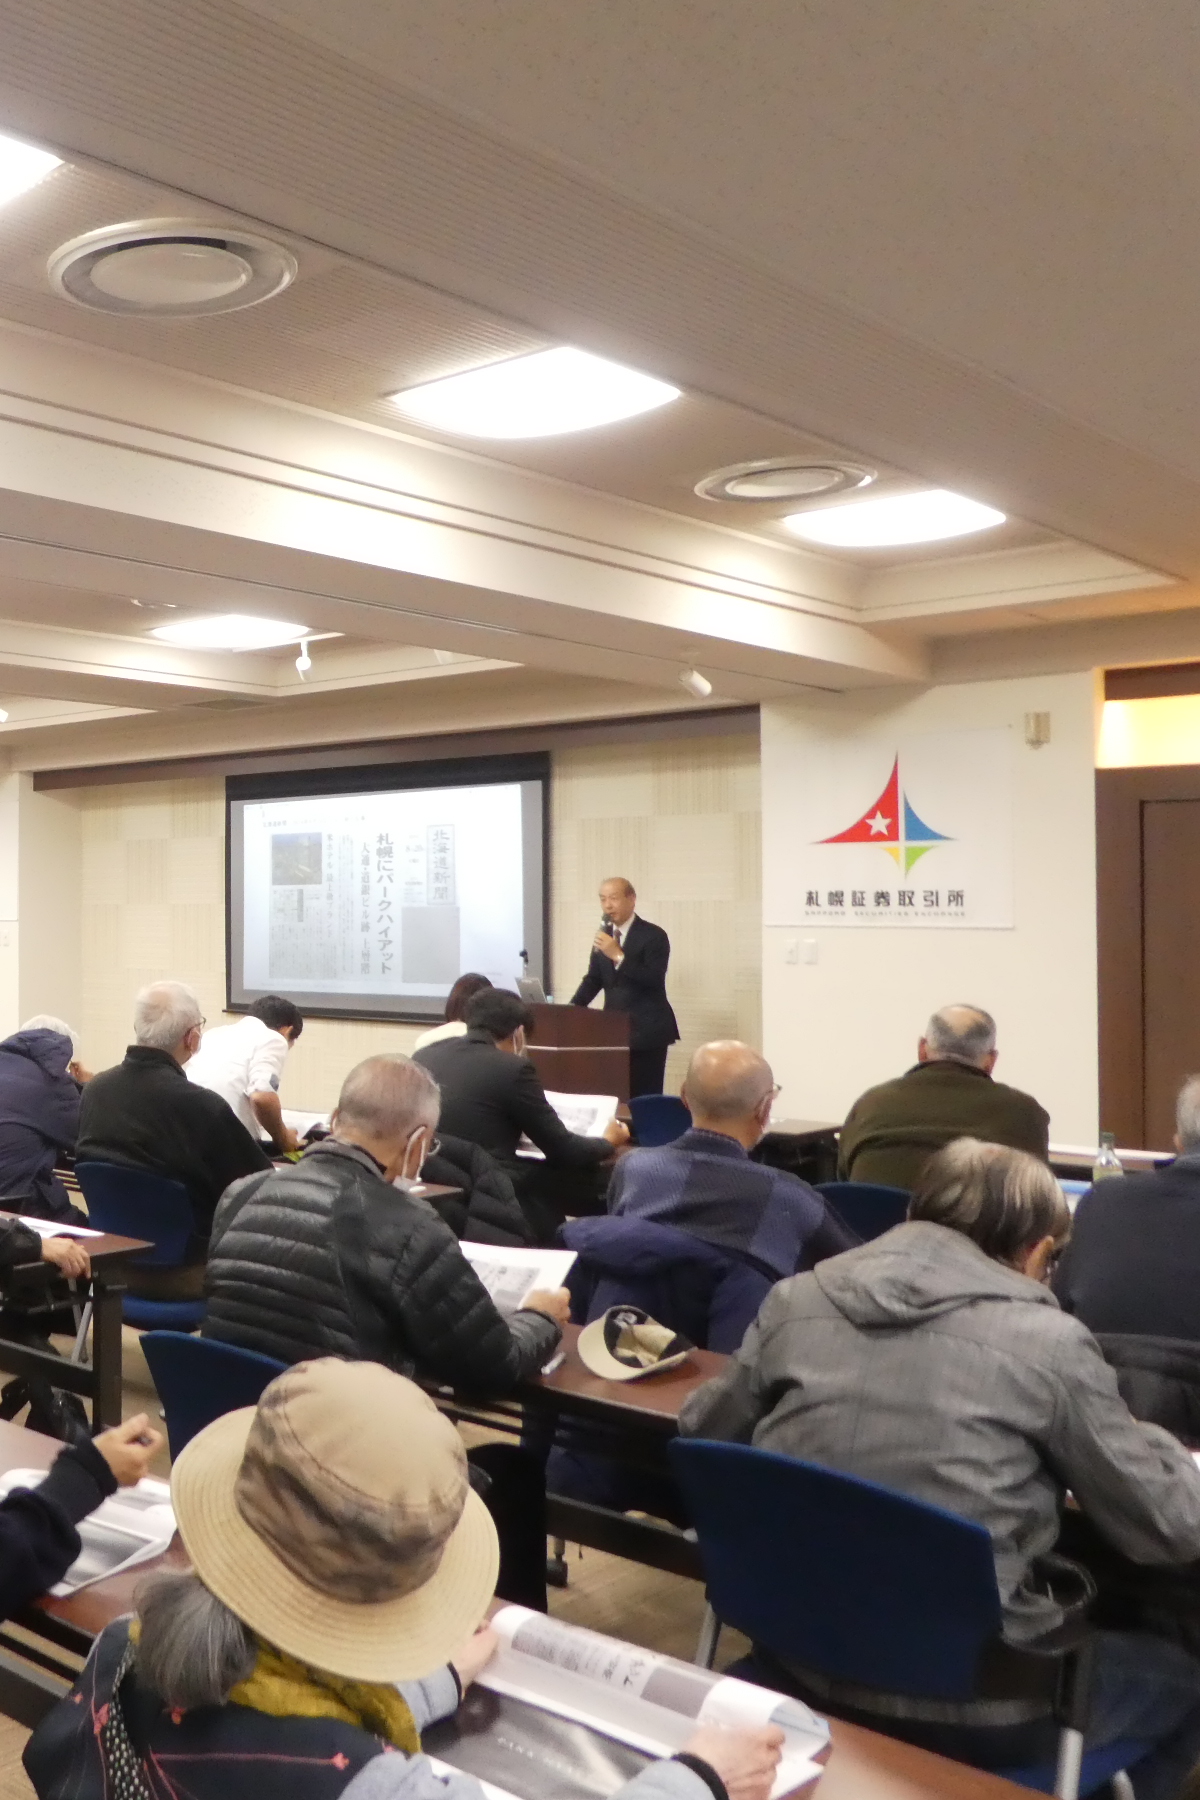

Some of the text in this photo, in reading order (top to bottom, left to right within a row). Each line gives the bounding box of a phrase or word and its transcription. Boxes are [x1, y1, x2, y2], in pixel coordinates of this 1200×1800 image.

[432, 829, 451, 900] 北海道新聞
[805, 889, 965, 908] 札幌証券取引所
[376, 833, 394, 975] 札幌にパークハイアット
